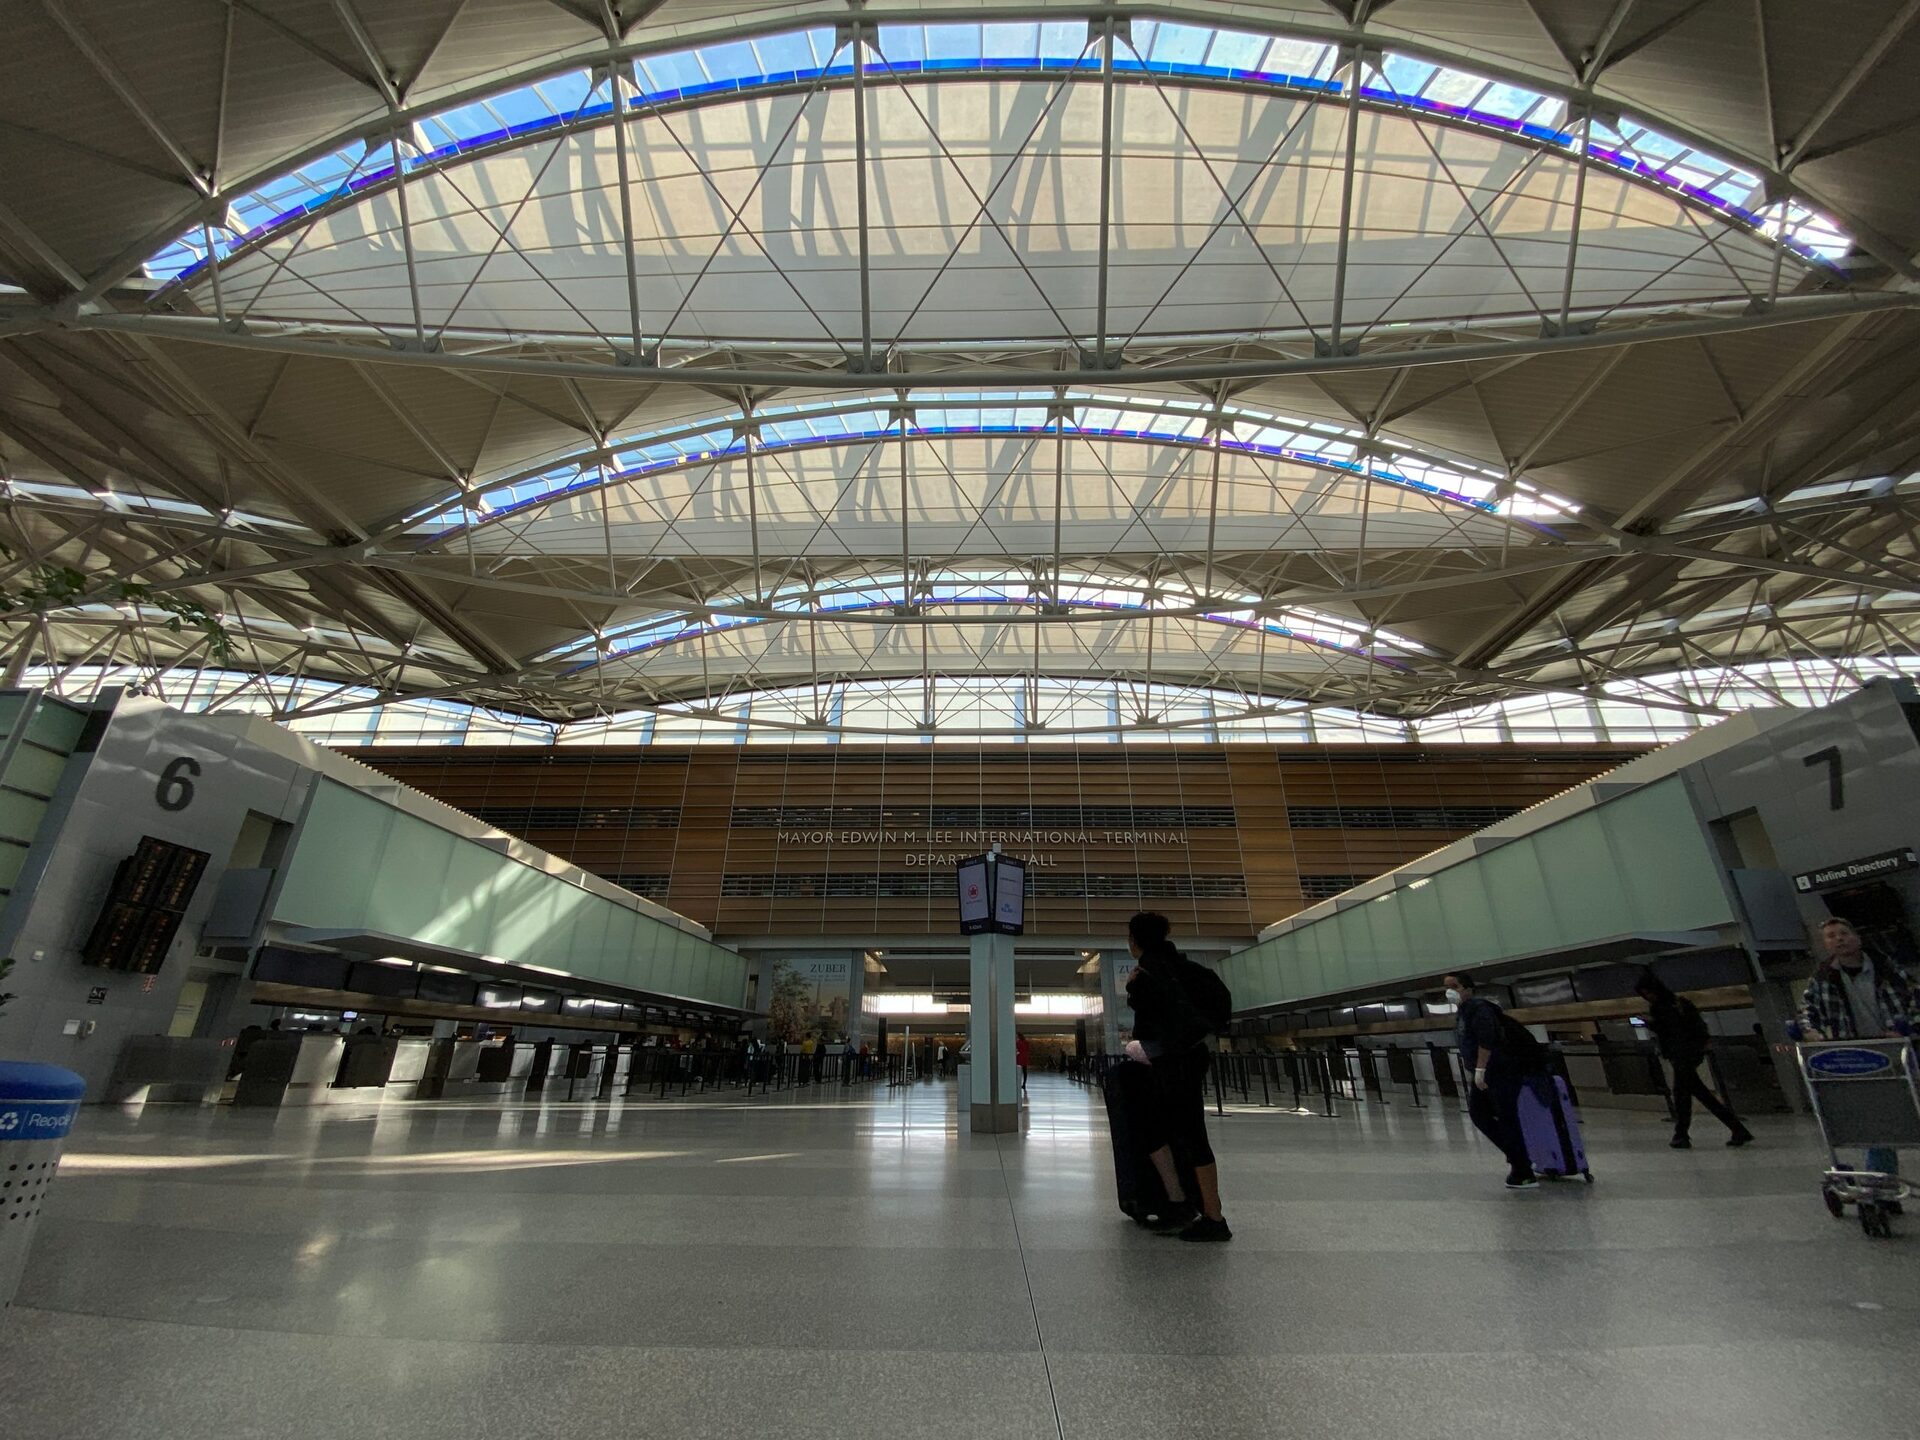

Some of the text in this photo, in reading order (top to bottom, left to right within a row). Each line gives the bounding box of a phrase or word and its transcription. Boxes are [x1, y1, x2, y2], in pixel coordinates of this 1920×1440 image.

[156, 756, 202, 812] 6
[1803, 745, 1844, 811] 7
[777, 831, 1189, 844] MAYOR EDWIN M. LEE INTERNATIONAL TERMINAL
[1814, 856, 1899, 884] Airline Directory
[809, 963, 846, 973] ZUBER
